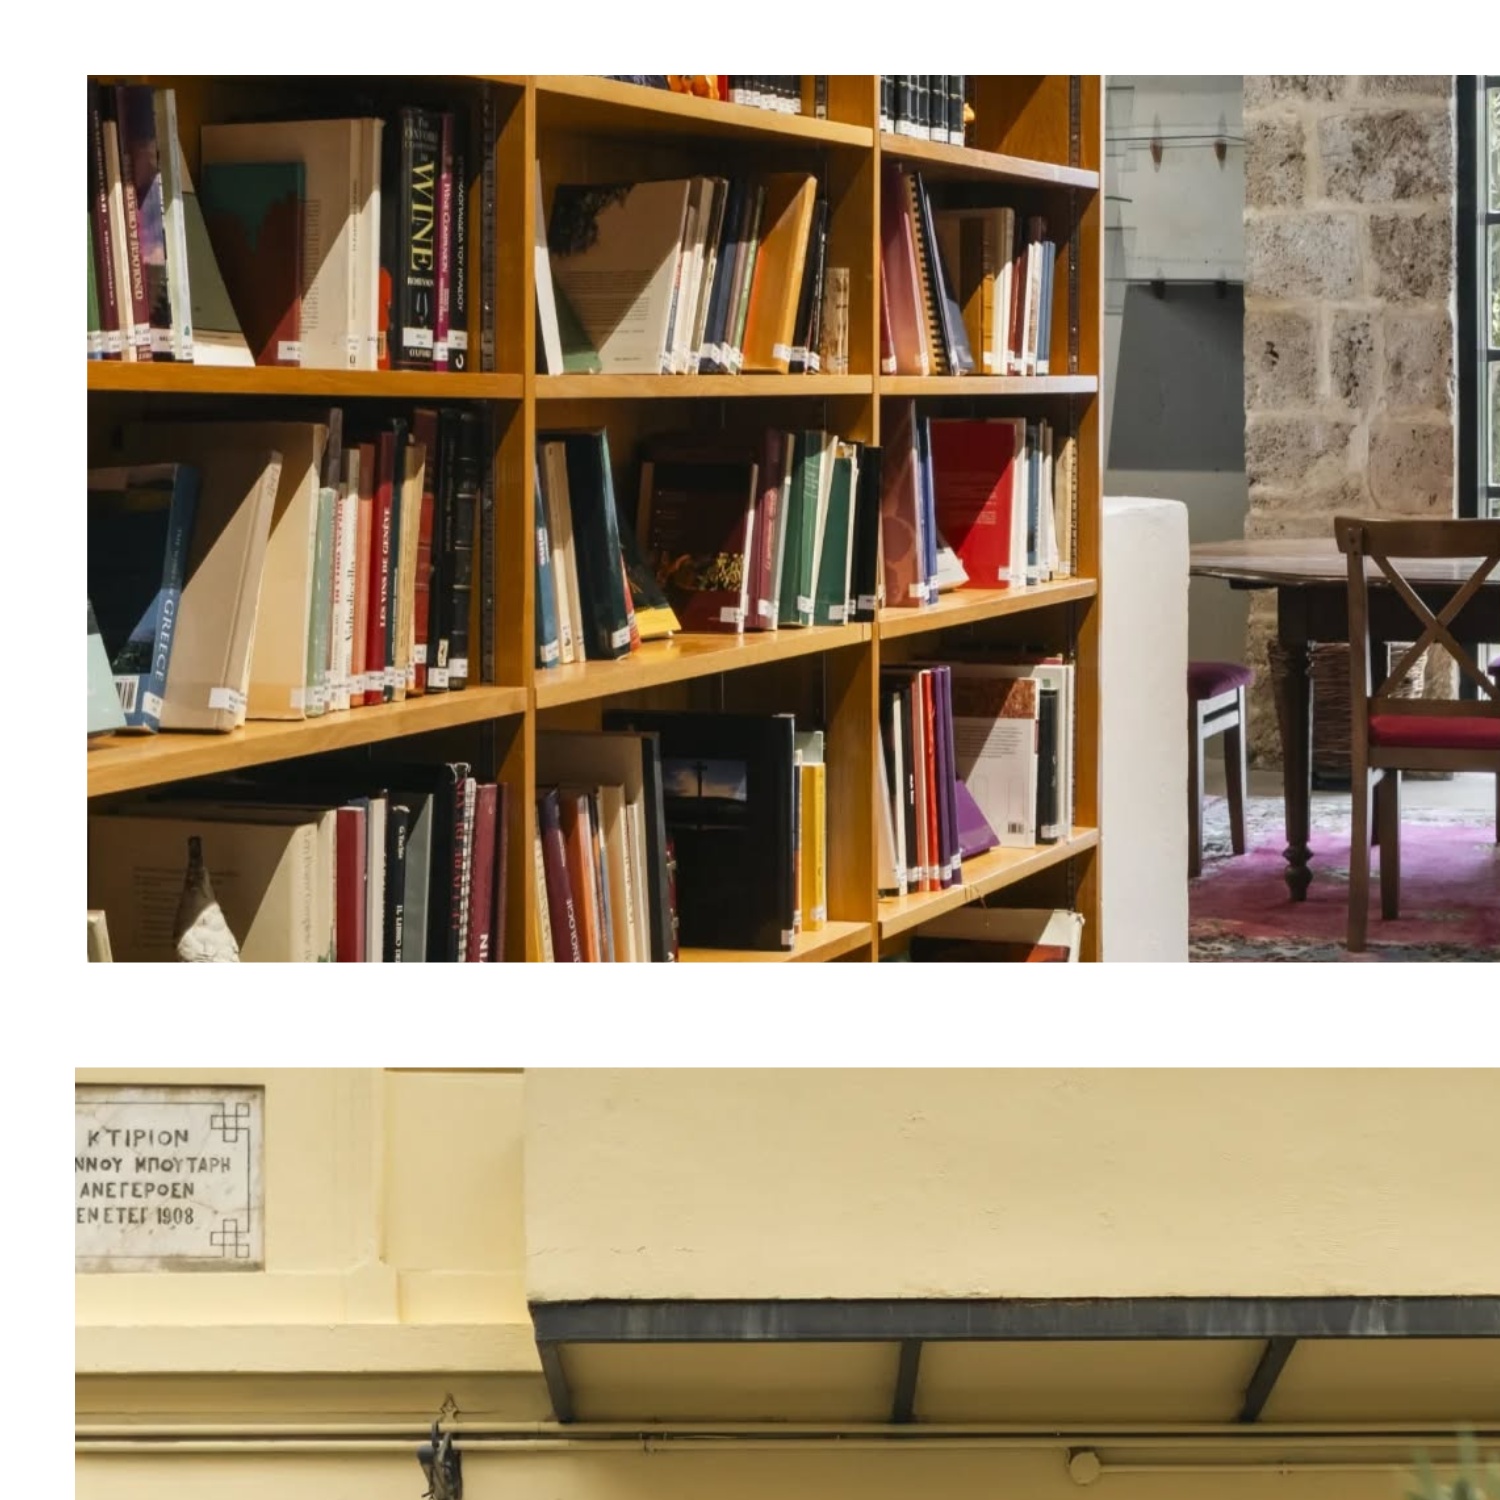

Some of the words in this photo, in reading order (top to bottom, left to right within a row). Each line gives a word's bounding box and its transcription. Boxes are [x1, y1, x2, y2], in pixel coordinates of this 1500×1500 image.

[411, 161, 435, 271] WINE
[155, 599, 174, 681] GREECE
[87, 1128, 190, 1148] ΚΤΙΡΙΟΝ
[134, 1156, 232, 1174] ΜΠΟΥΤΑΡΗ
[156, 1206, 195, 1226] 1908
